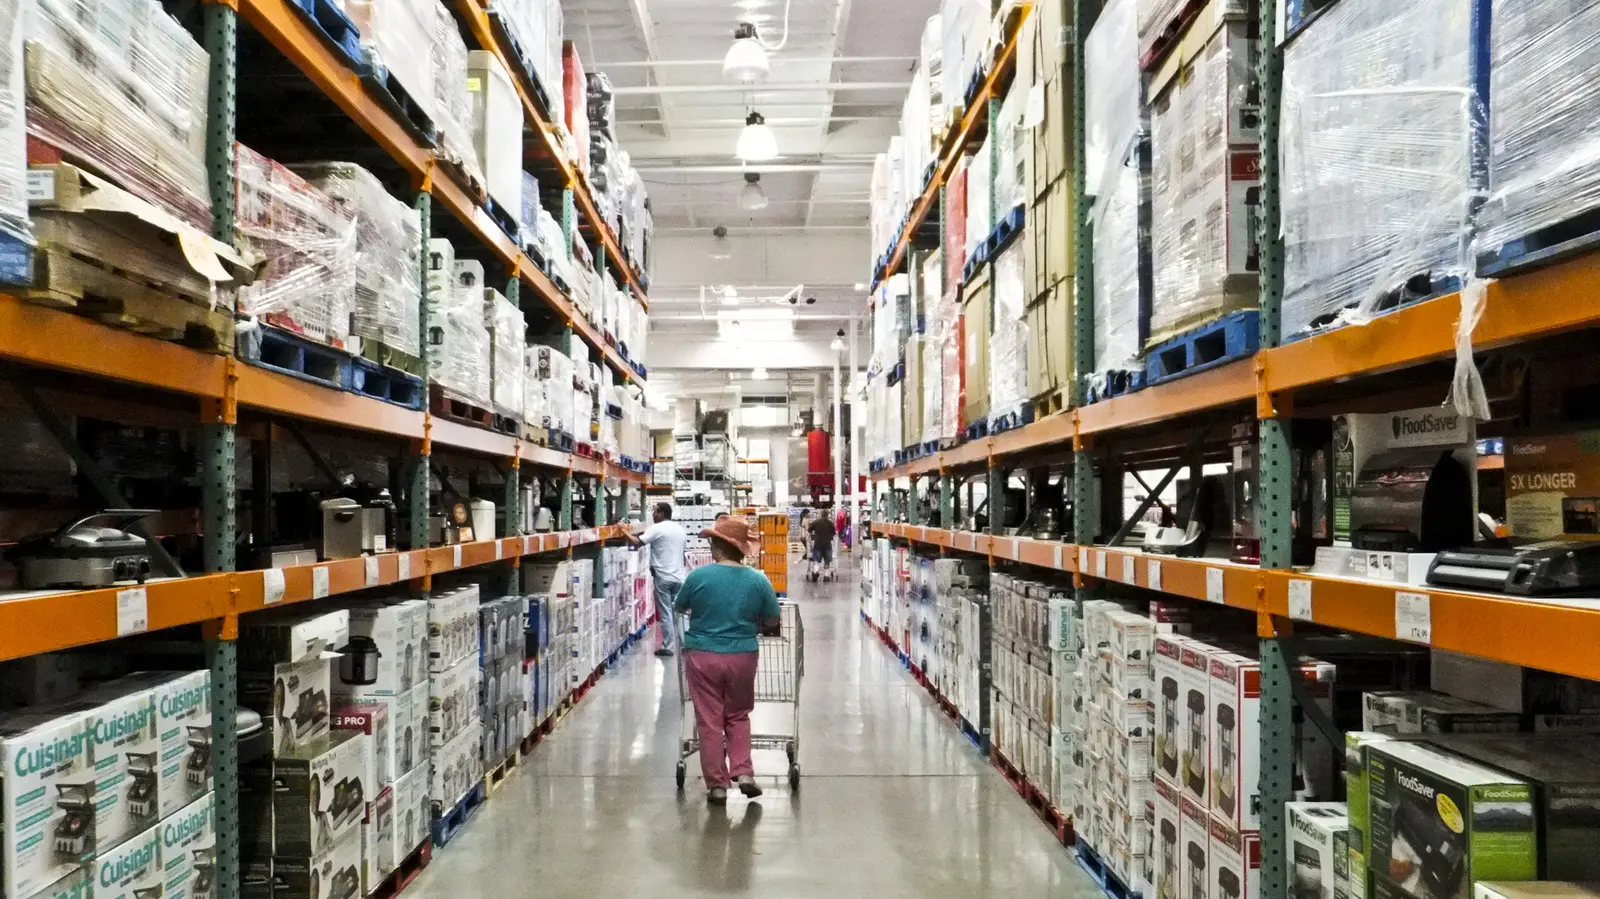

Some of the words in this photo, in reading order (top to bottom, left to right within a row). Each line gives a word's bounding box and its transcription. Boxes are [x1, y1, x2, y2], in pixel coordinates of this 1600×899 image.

[1402, 413, 1458, 436] FoodSaver
[1527, 473, 1577, 489] LONGER
[1060, 606, 1068, 648] Cuisinart
[160, 682, 211, 718] Cuisinart
[94, 703, 156, 744] Cuisinart
[344, 716, 366, 726] PRO
[15, 727, 95, 777] Cuisinart
[1397, 770, 1435, 800] FoodSaver
[164, 803, 215, 847] Cuisinart
[100, 836, 162, 888] Cuisinart
